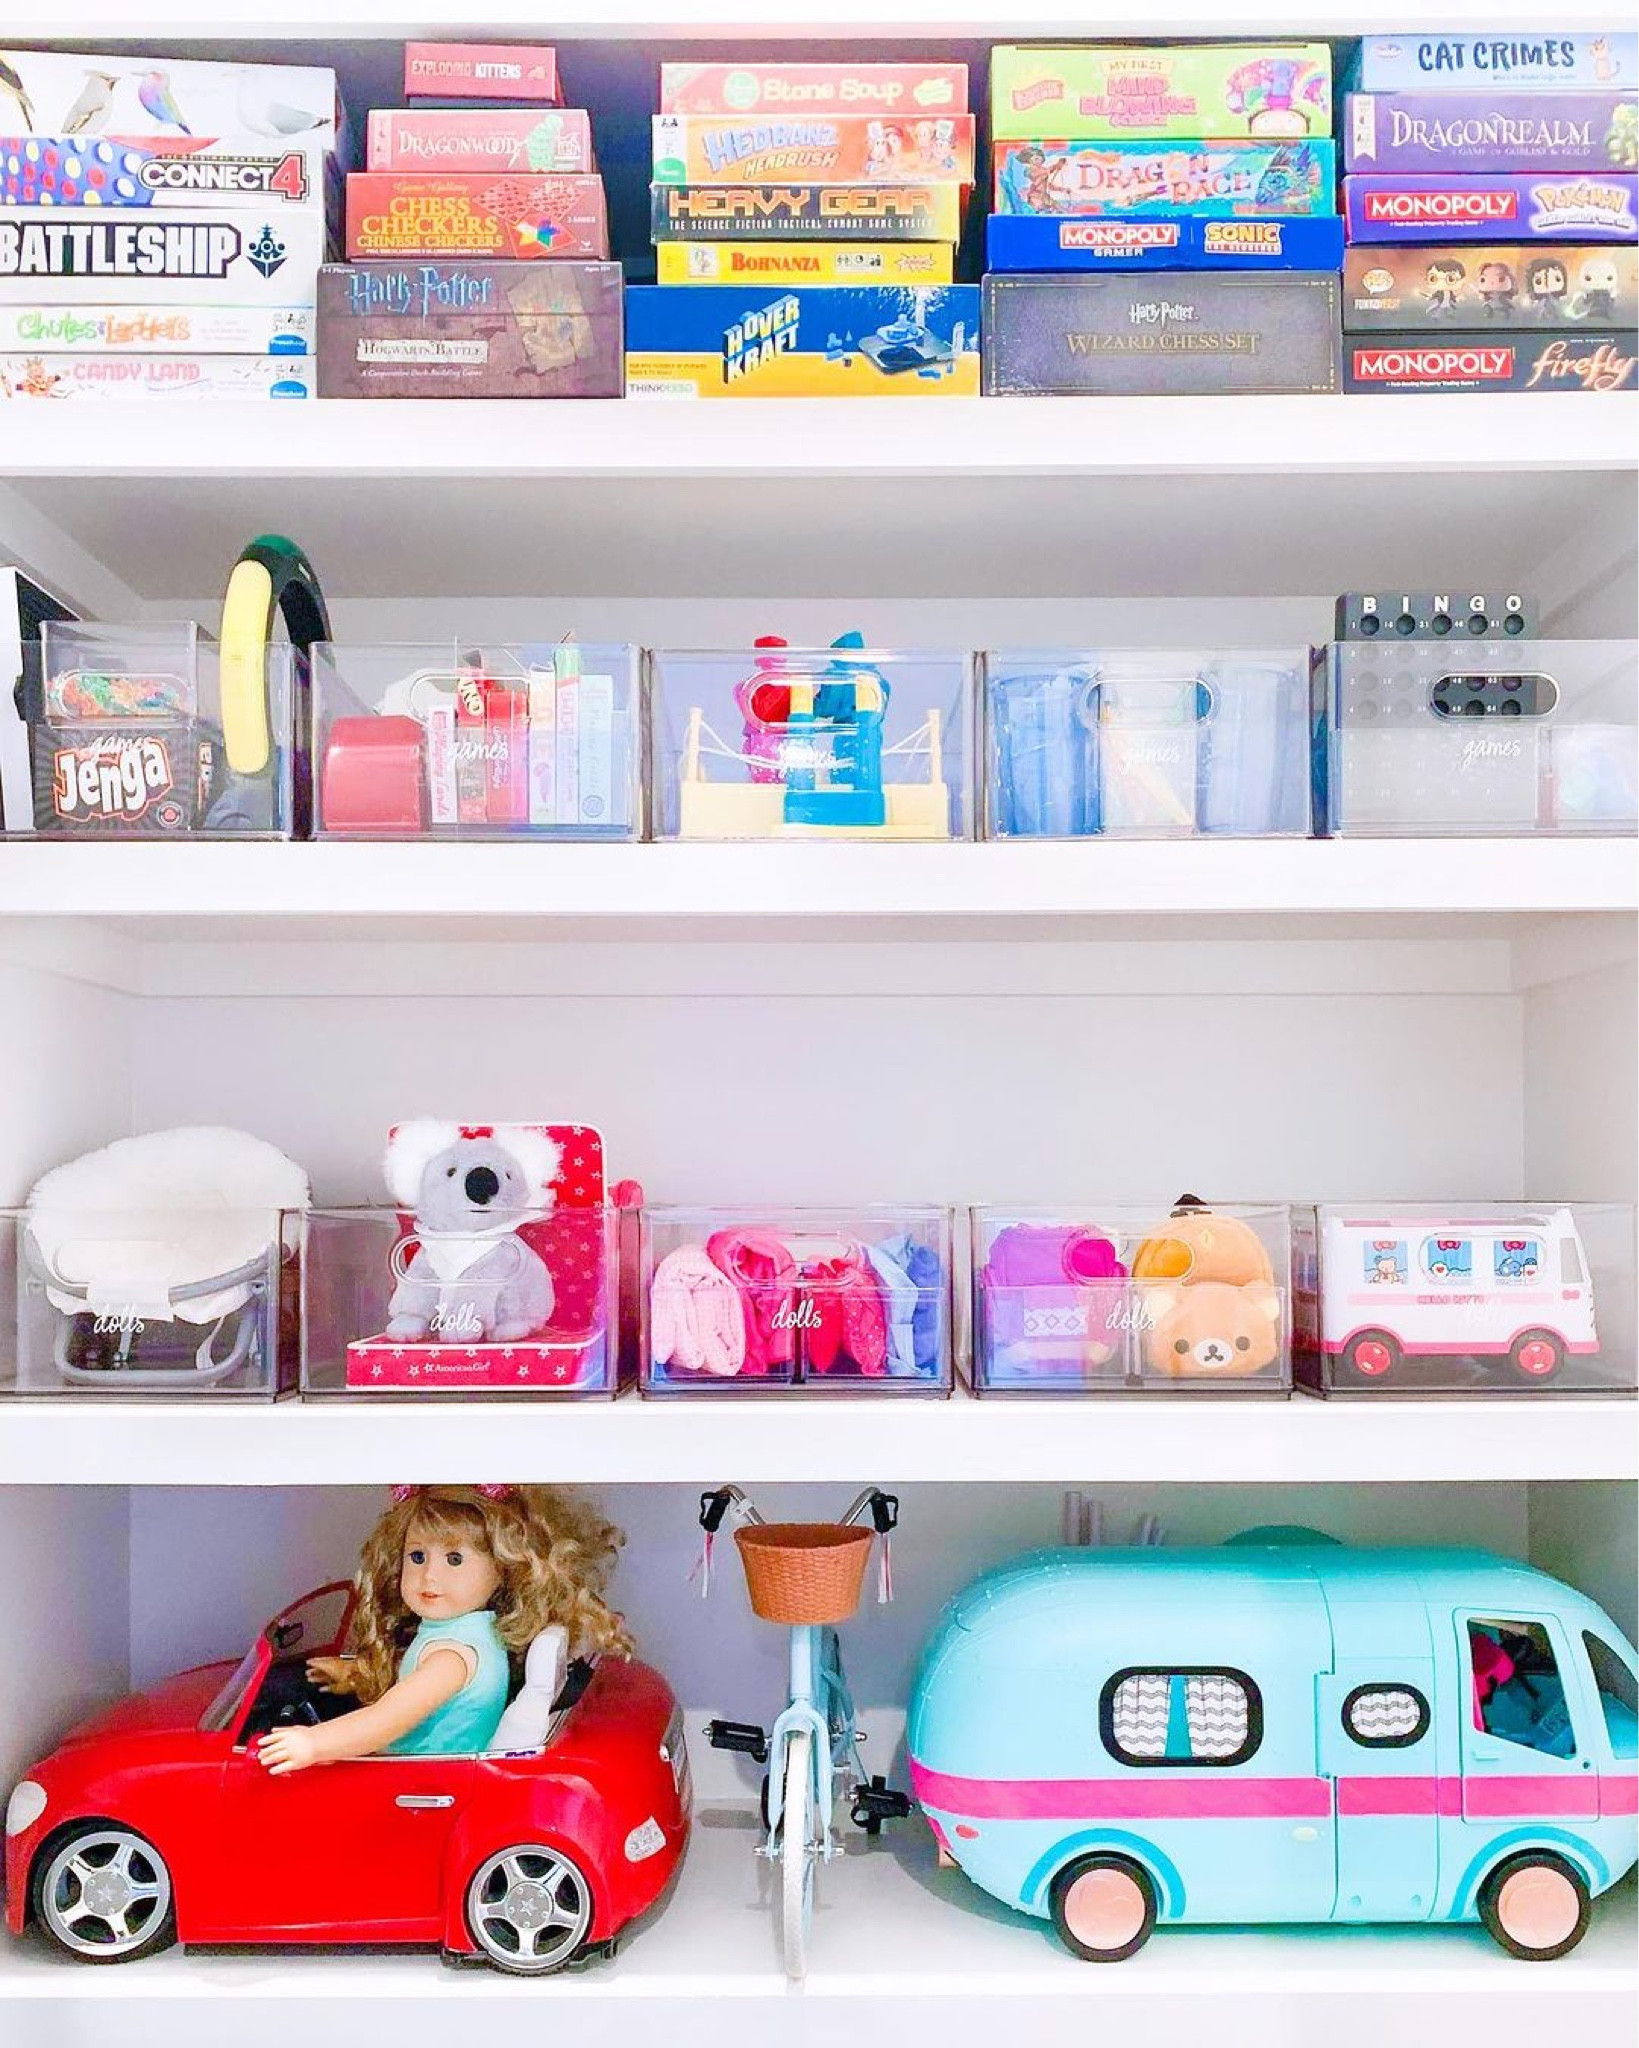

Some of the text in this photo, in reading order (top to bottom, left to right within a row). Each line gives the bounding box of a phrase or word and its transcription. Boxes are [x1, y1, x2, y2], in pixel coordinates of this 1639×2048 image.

[412, 59, 522, 79] EXPLODING KITTENS
[1418, 41, 1465, 71] CAT
[1473, 39, 1575, 72] CRIMES
[762, 78, 835, 101] Stone
[839, 78, 905, 106] Soup
[398, 128, 519, 160] DRAGONWOOD
[1390, 108, 1596, 152] DRAGONREALM
[142, 152, 308, 200] CONNECT 4
[743, 150, 840, 180] HEADRUSH
[668, 189, 937, 217] HEAVY GEAR
[1170, 170, 1252, 206] RACE
[389, 196, 471, 217] CHESS
[1371, 195, 1512, 217] MONOPOLY
[362, 215, 498, 235] CHECKERS
[691, 219, 731, 230] SCIENCE
[735, 219, 773, 230] FICTION
[778, 219, 821, 229] TACTICAL
[827, 219, 863, 228] COMBAT
[868, 219, 893, 228] GAME
[1063, 225, 1172, 245] MONOPOLY
[1207, 224, 1278, 242] SONIC
[0, 221, 242, 278] BATTLESHIP
[356, 235, 504, 248] CHINESE CHECKERS
[731, 252, 821, 271] BOHNANZA
[344, 266, 492, 326] Harry Potter
[18, 311, 98, 343] Chutes
[724, 293, 800, 358] HOVER
[1129, 301, 1194, 327] Harry Potter
[436, 342, 480, 355] BATTLE
[724, 322, 799, 384] KRAFT
[1067, 333, 1261, 354] WIZARD CHESS SET
[73, 362, 201, 381] CANDY LAND
[1360, 353, 1506, 376] MONOPOLY
[1525, 340, 1638, 391] firefly
[449, 741, 509, 772] games
[1461, 739, 1522, 772] games
[59, 742, 169, 813] Jenga
[93, 1304, 145, 1335] dolls
[430, 1300, 482, 1333] dolls
[771, 1299, 822, 1330] dolls
[1105, 1300, 1156, 1330] dolls
